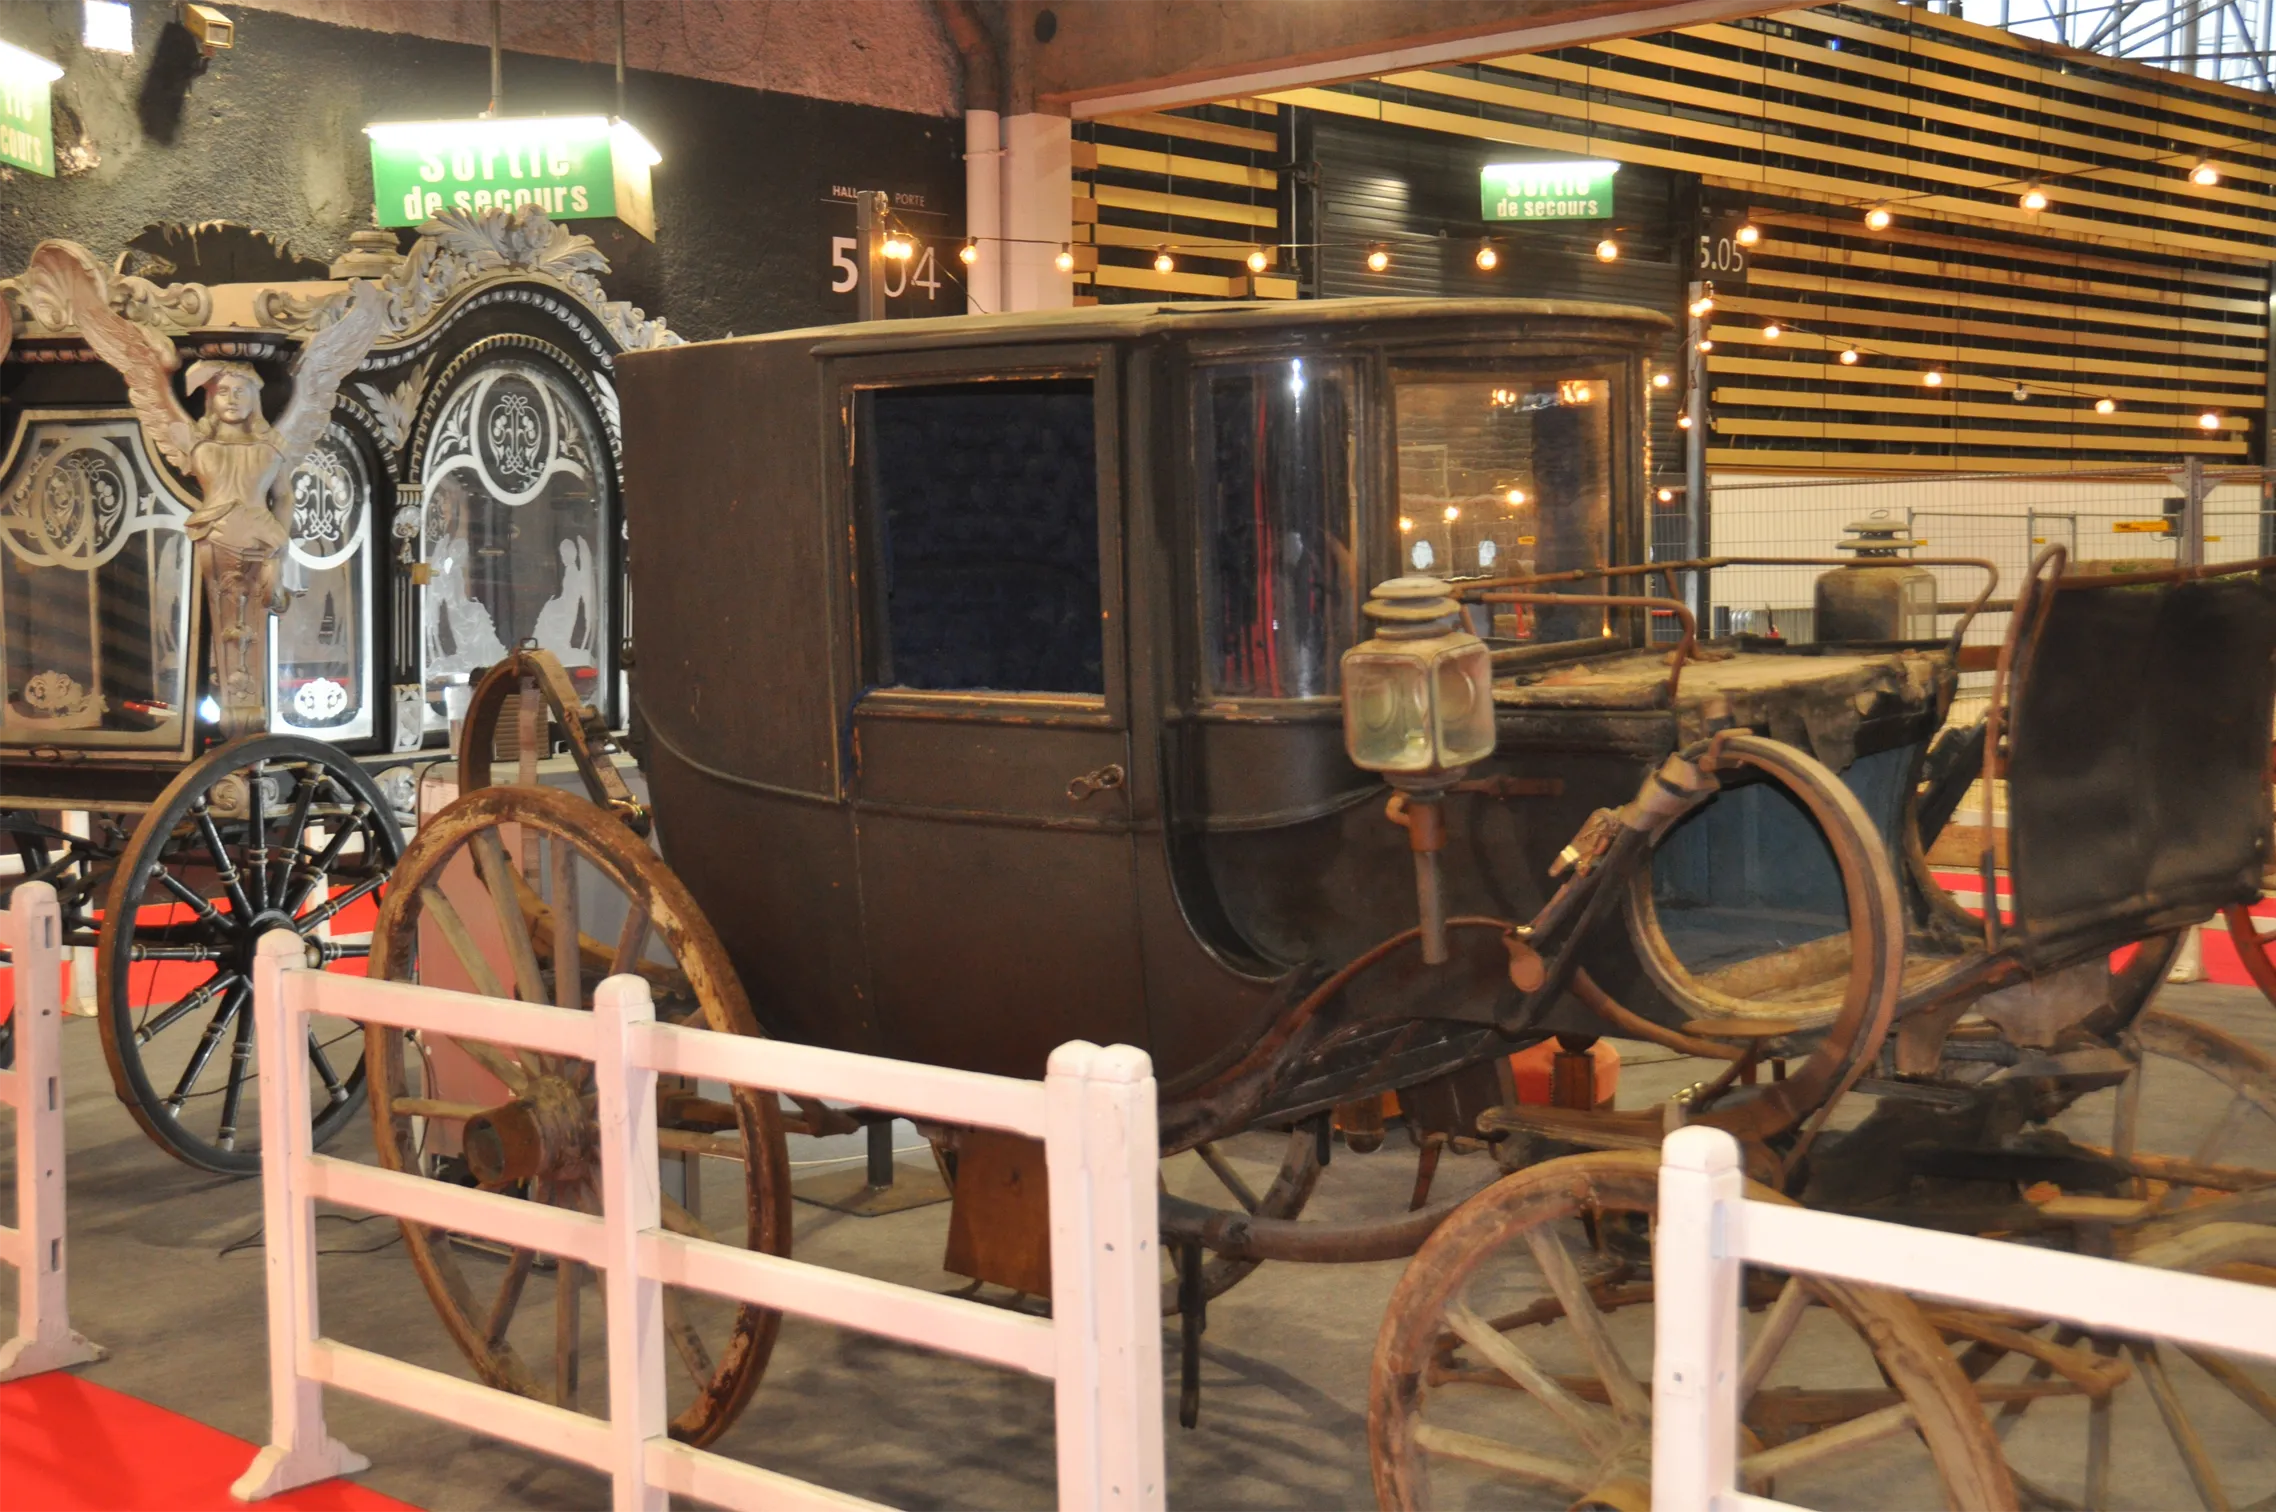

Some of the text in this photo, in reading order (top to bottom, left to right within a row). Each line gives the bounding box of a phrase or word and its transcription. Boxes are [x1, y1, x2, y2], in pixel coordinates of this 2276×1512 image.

[403, 184, 590, 221] de secours
[832, 185, 925, 207] HALL PORTE
[1497, 198, 1599, 217] de secours
[1700, 235, 1743, 272] 5.05
